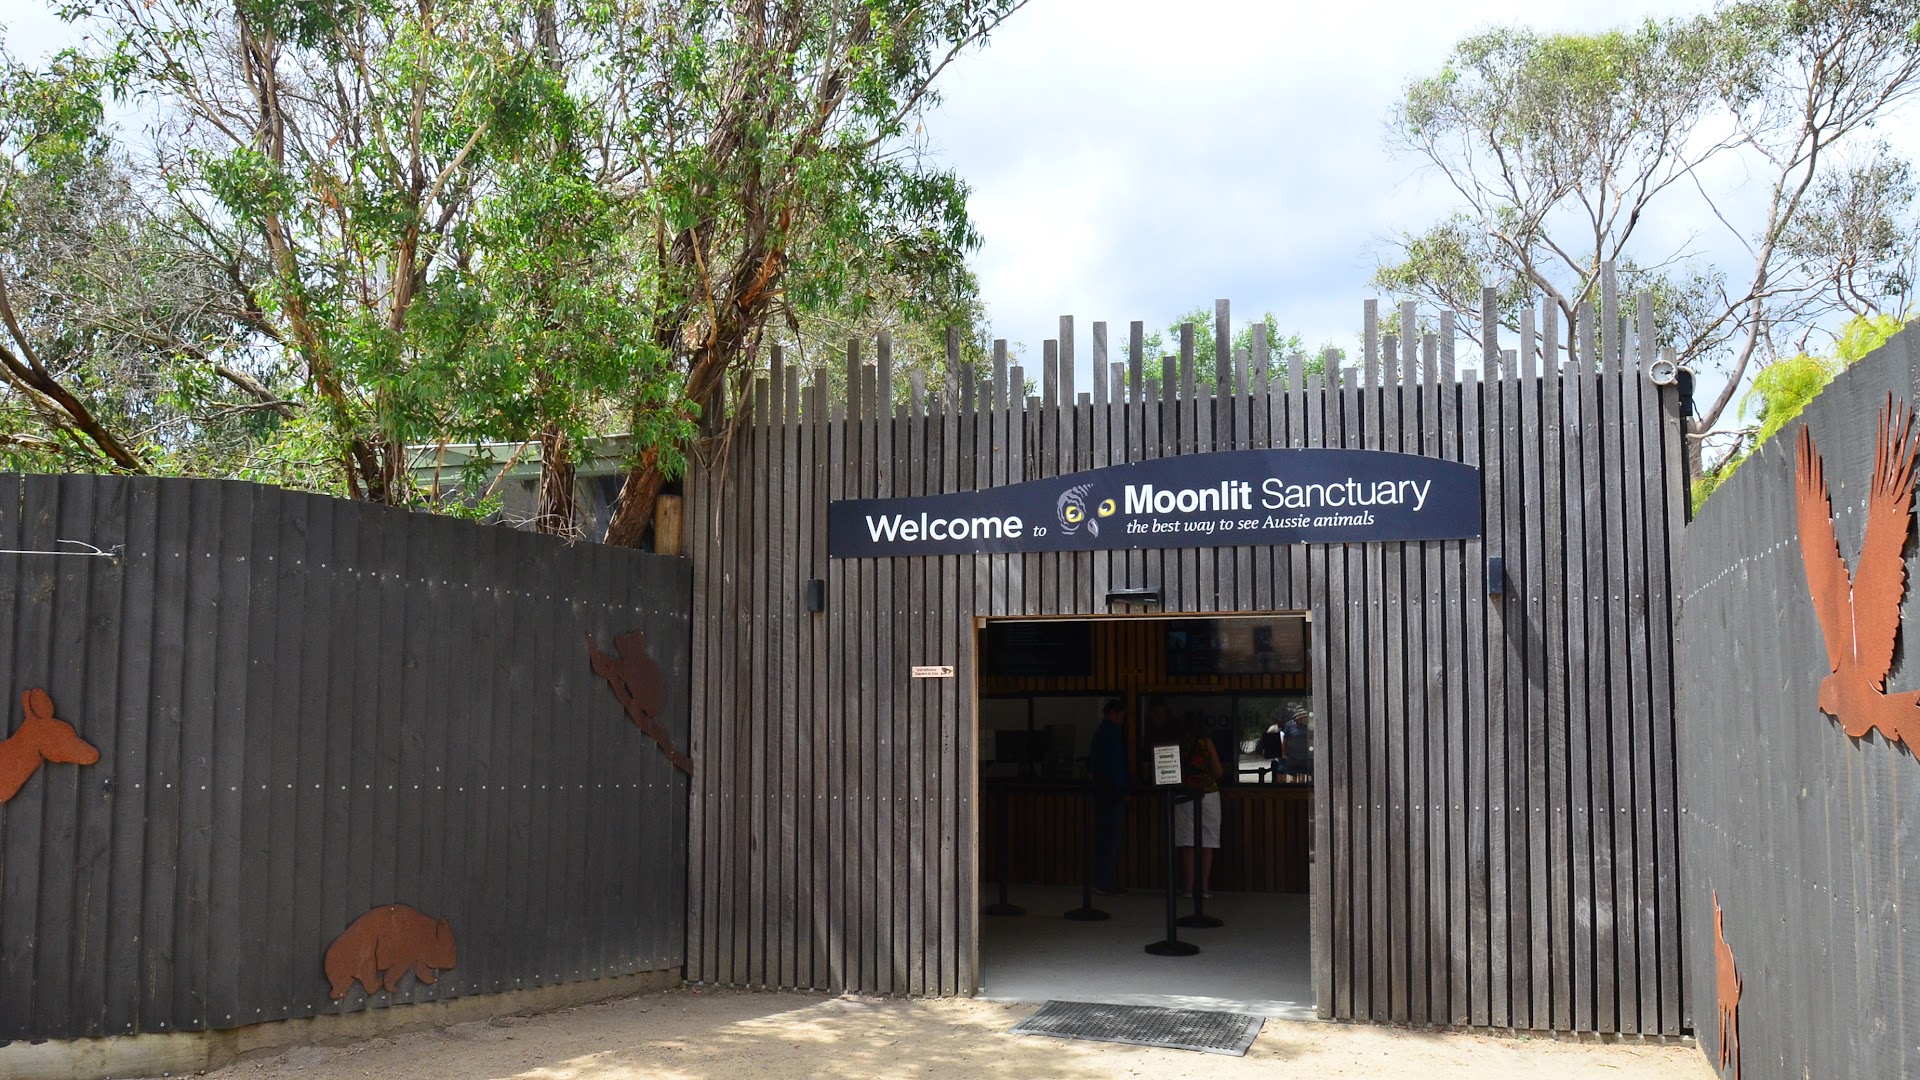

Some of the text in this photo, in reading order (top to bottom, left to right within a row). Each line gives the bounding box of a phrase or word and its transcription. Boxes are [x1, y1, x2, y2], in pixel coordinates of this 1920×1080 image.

[1124, 477, 1432, 515] Moonlit Sanctuary
[865, 514, 1047, 543] Welcome to
[1126, 509, 1375, 535] the best way to see Aussie animals
